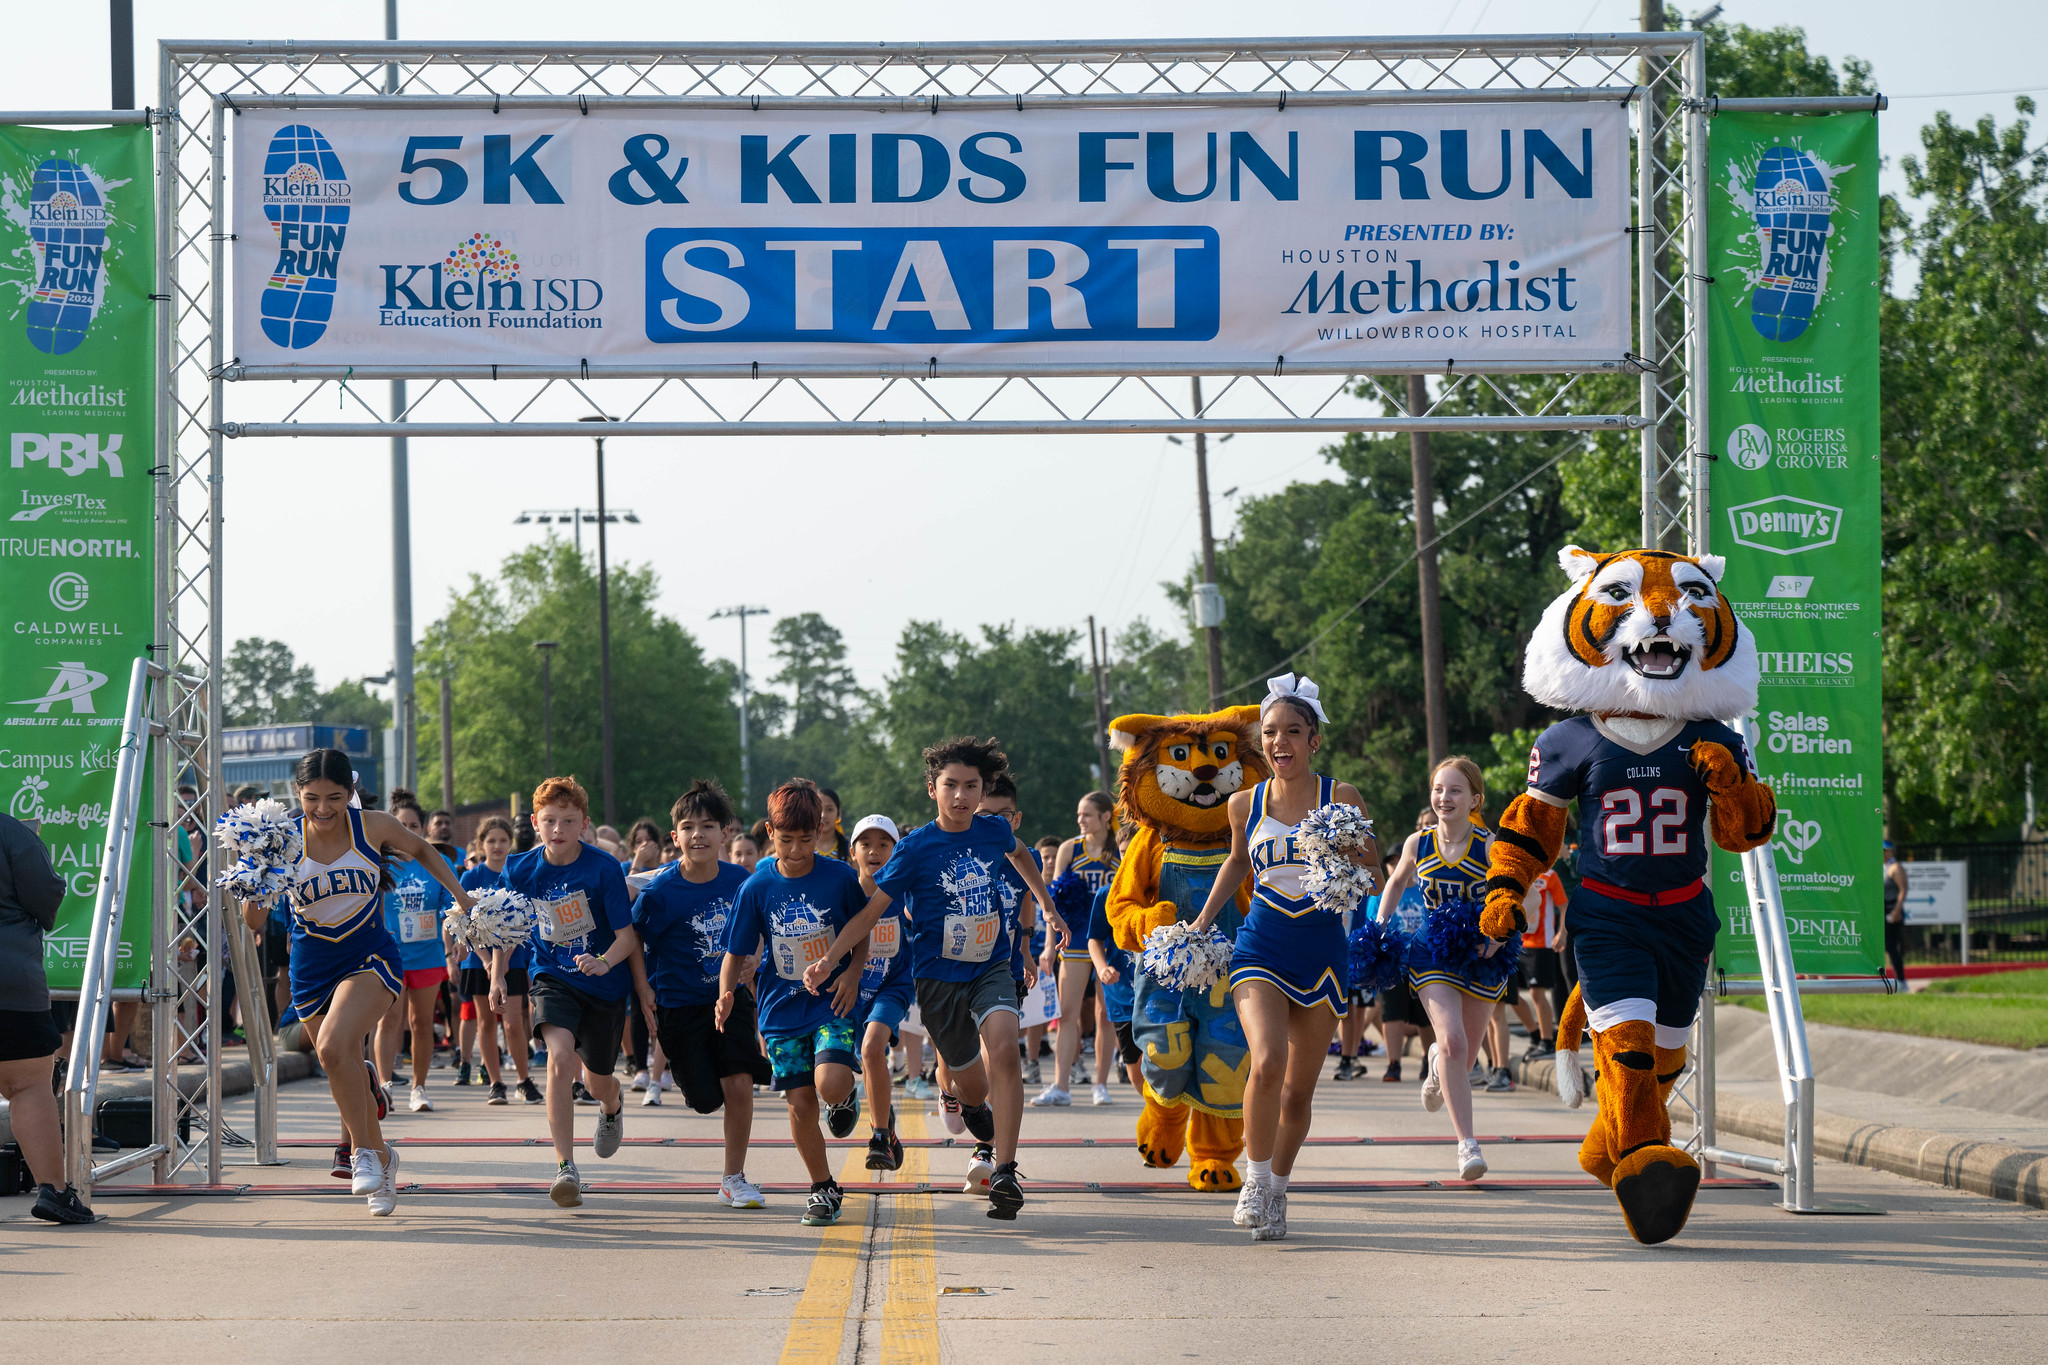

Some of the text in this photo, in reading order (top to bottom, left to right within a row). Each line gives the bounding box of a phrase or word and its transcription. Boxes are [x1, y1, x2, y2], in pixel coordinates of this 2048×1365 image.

[398, 128, 1593, 206] 5K & KIDS FUN RUN
[263, 177, 351, 196] Klein ISD
[1755, 191, 1831, 207] Klein ISD
[30, 204, 106, 221] Klein ISD
[281, 223, 347, 252] FUN
[1344, 224, 1514, 242] PRESENTED BY:
[1771, 228, 1827, 255] FUN
[45, 243, 103, 269] FUN
[274, 249, 340, 279] RUN
[1282, 249, 1398, 264] HOUSTON
[1764, 253, 1821, 280] RUN
[38, 267, 98, 293] RUN
[379, 261, 604, 311] Klein ISD
[660, 239, 1205, 332] START
[1281, 259, 1578, 315] Methodist
[1793, 281, 1817, 291] 2024
[68, 294, 94, 304] 2024
[379, 310, 603, 329] Education Foundation
[1317, 324, 1577, 341] WILLOWBROOK HOSPITAL
[1762, 356, 1802, 364] PRESENTED
[1729, 366, 1774, 374] HOUSTON
[1730, 371, 1844, 394] Methodist
[10, 384, 127, 407] Methodist
[1776, 427, 1846, 442] ROGERS
[10, 432, 124, 478] PBK
[1776, 455, 1849, 469] GROVER
[21, 489, 107, 510] InvesTex
[1739, 509, 1831, 538] Denny's
[1732, 602, 1860, 611] TTERFIELD & PONTIKES
[1824, 612, 1848, 620] INC.
[14, 621, 123, 635] CALDWELL
[35, 638, 102, 646] COMPANIES
[1757, 652, 1853, 675] THEISS
[1815, 678, 1850, 686] AGENCY
[4, 717, 59, 726] ABSOLUTE
[61, 718, 82, 726] ALL
[1768, 710, 1829, 732] Salas
[1768, 732, 1852, 754] O'Brien
[0, 749, 75, 775] Campus
[1626, 766, 1661, 779] COLLINS
[1782, 772, 1863, 788] financial
[1601, 786, 1689, 856] 22
[1250, 836, 1306, 875] KLE
[296, 867, 377, 906] KLEIN
[1778, 872, 1855, 887] ermatology
[965, 893, 988, 906] FUN
[555, 899, 583, 925] 193
[419, 915, 434, 929] 153
[873, 924, 895, 943] 168
[976, 919, 999, 945] 207
[1819, 935, 1862, 946] GROUP
[803, 936, 830, 962] 301
